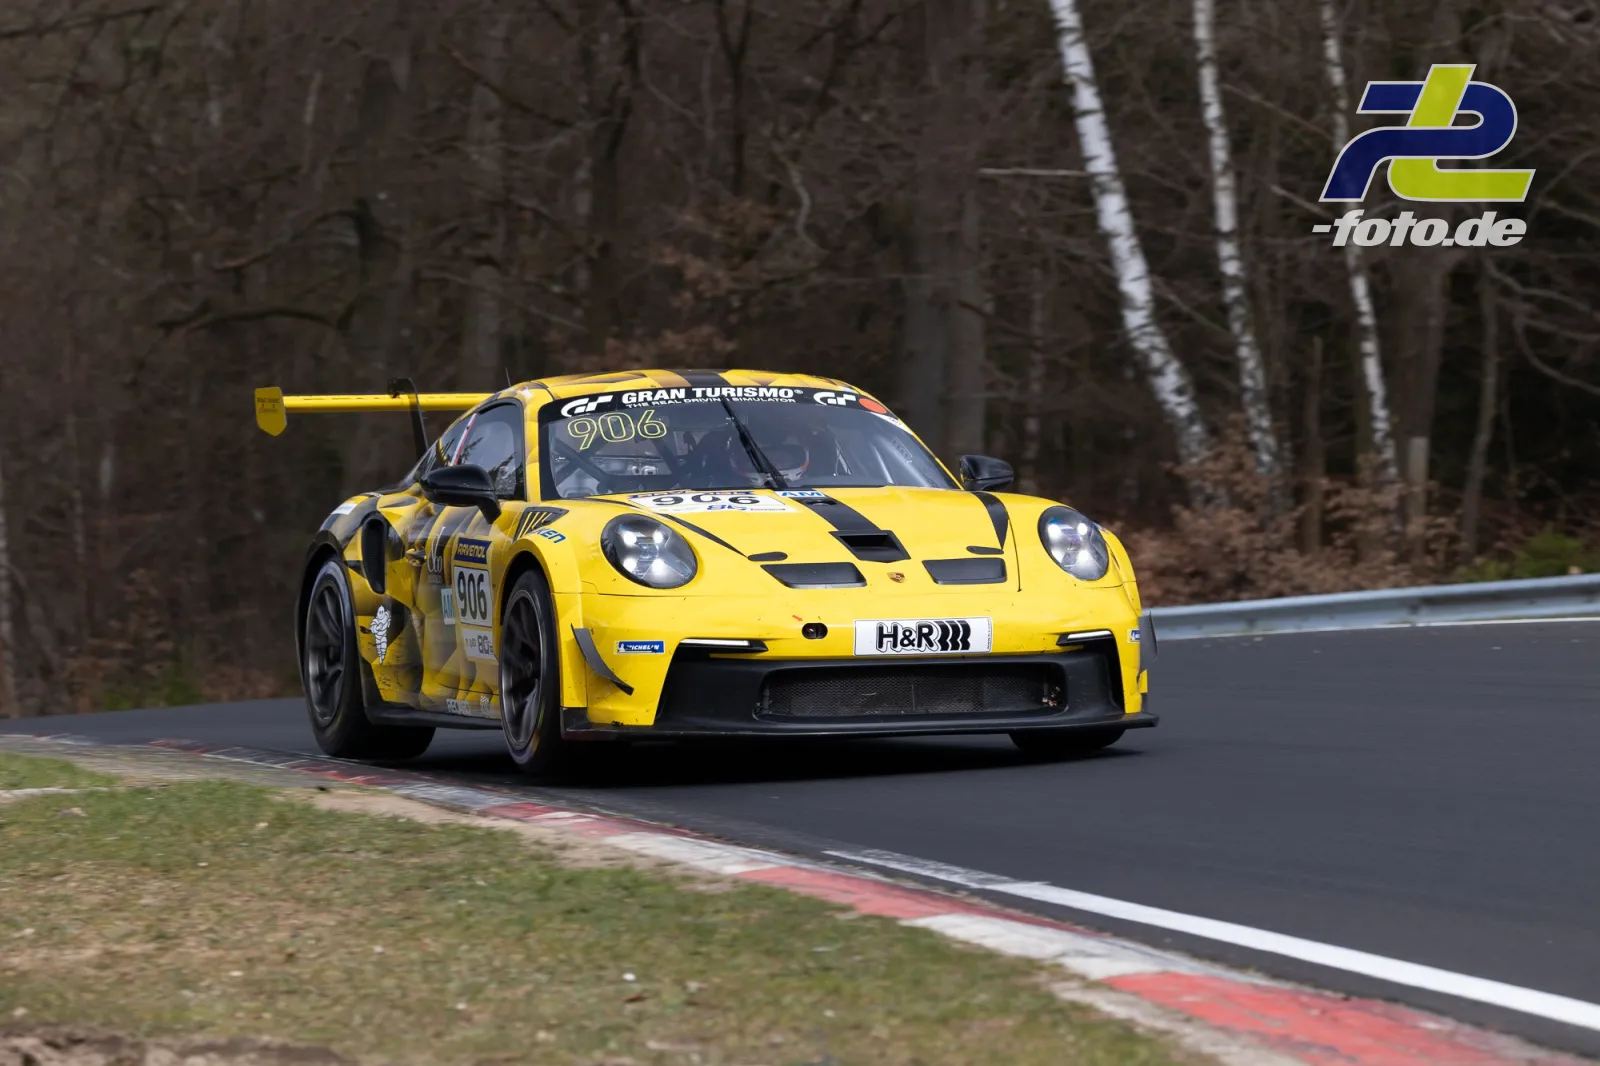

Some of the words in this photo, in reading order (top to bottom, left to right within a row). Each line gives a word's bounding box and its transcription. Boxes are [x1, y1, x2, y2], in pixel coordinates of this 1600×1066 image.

[622, 388, 686, 404] GRAN
[567, 410, 667, 450] 906
[652, 494, 760, 506] 906
[457, 571, 488, 620] 906
[876, 622, 937, 652] H&R
